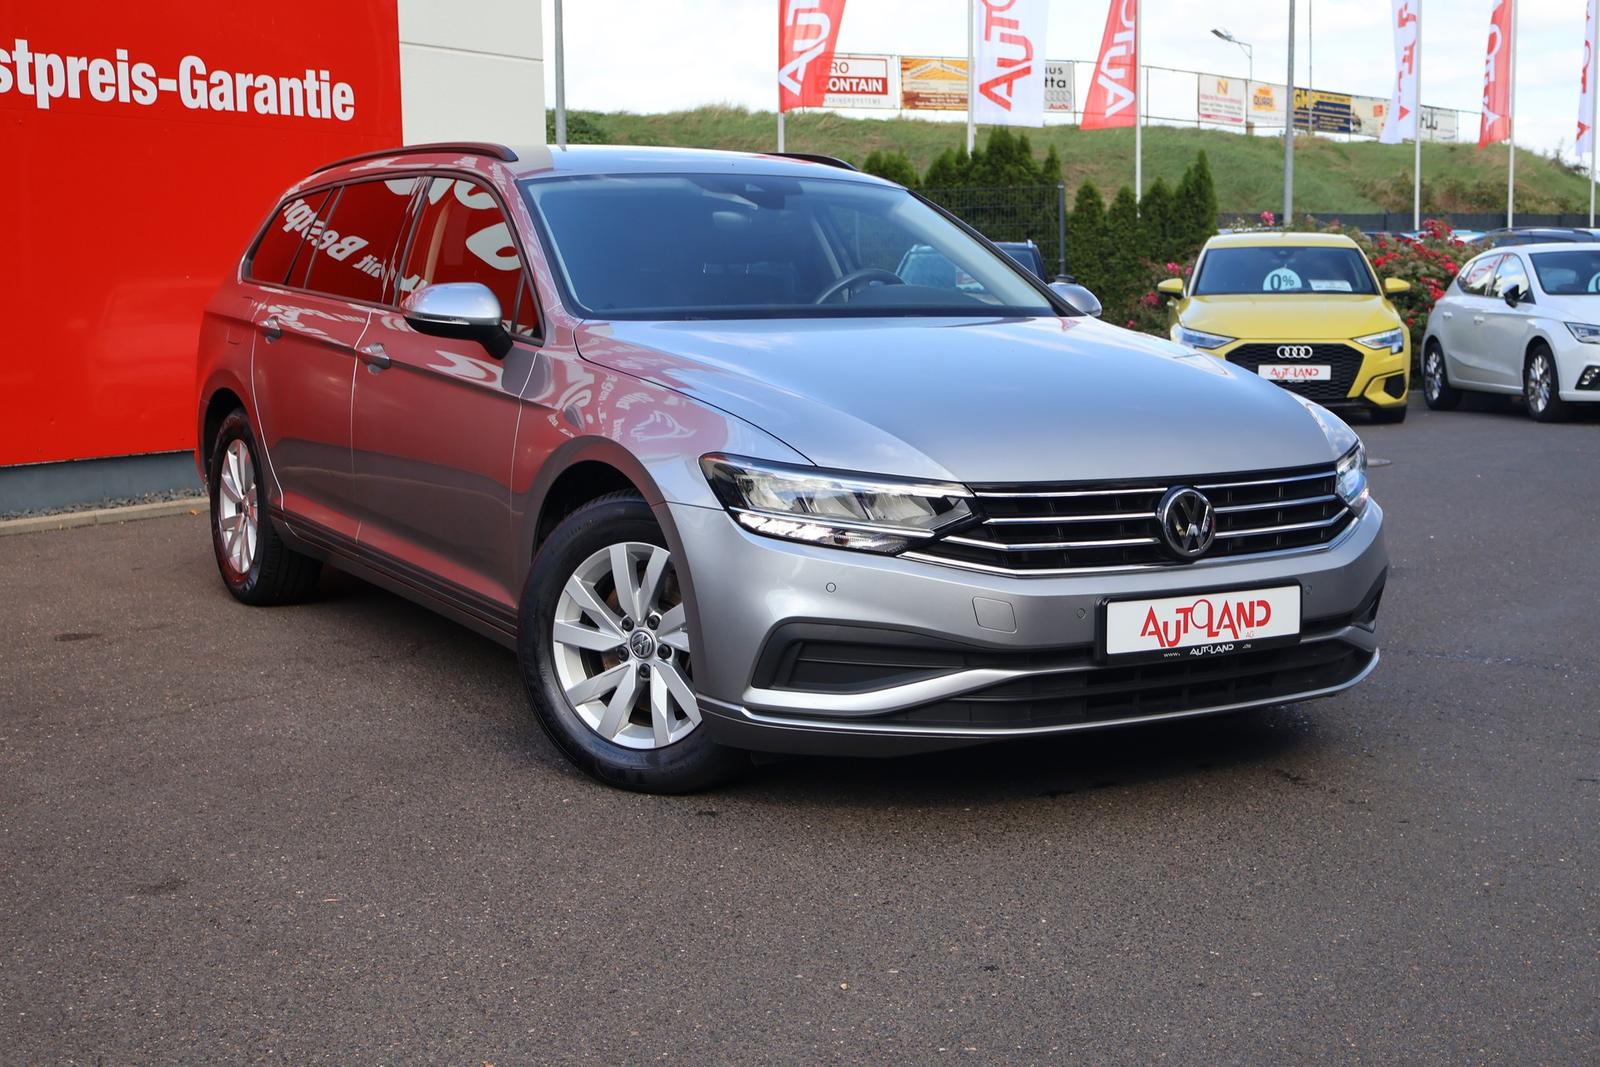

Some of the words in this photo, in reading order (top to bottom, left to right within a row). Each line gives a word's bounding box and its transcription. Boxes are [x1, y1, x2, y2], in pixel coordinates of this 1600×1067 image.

[819, 77, 883, 93] ONTAIN
[1271, 367, 1319, 379] AUTOLAND
[1140, 598, 1272, 648] AUTOLAND
